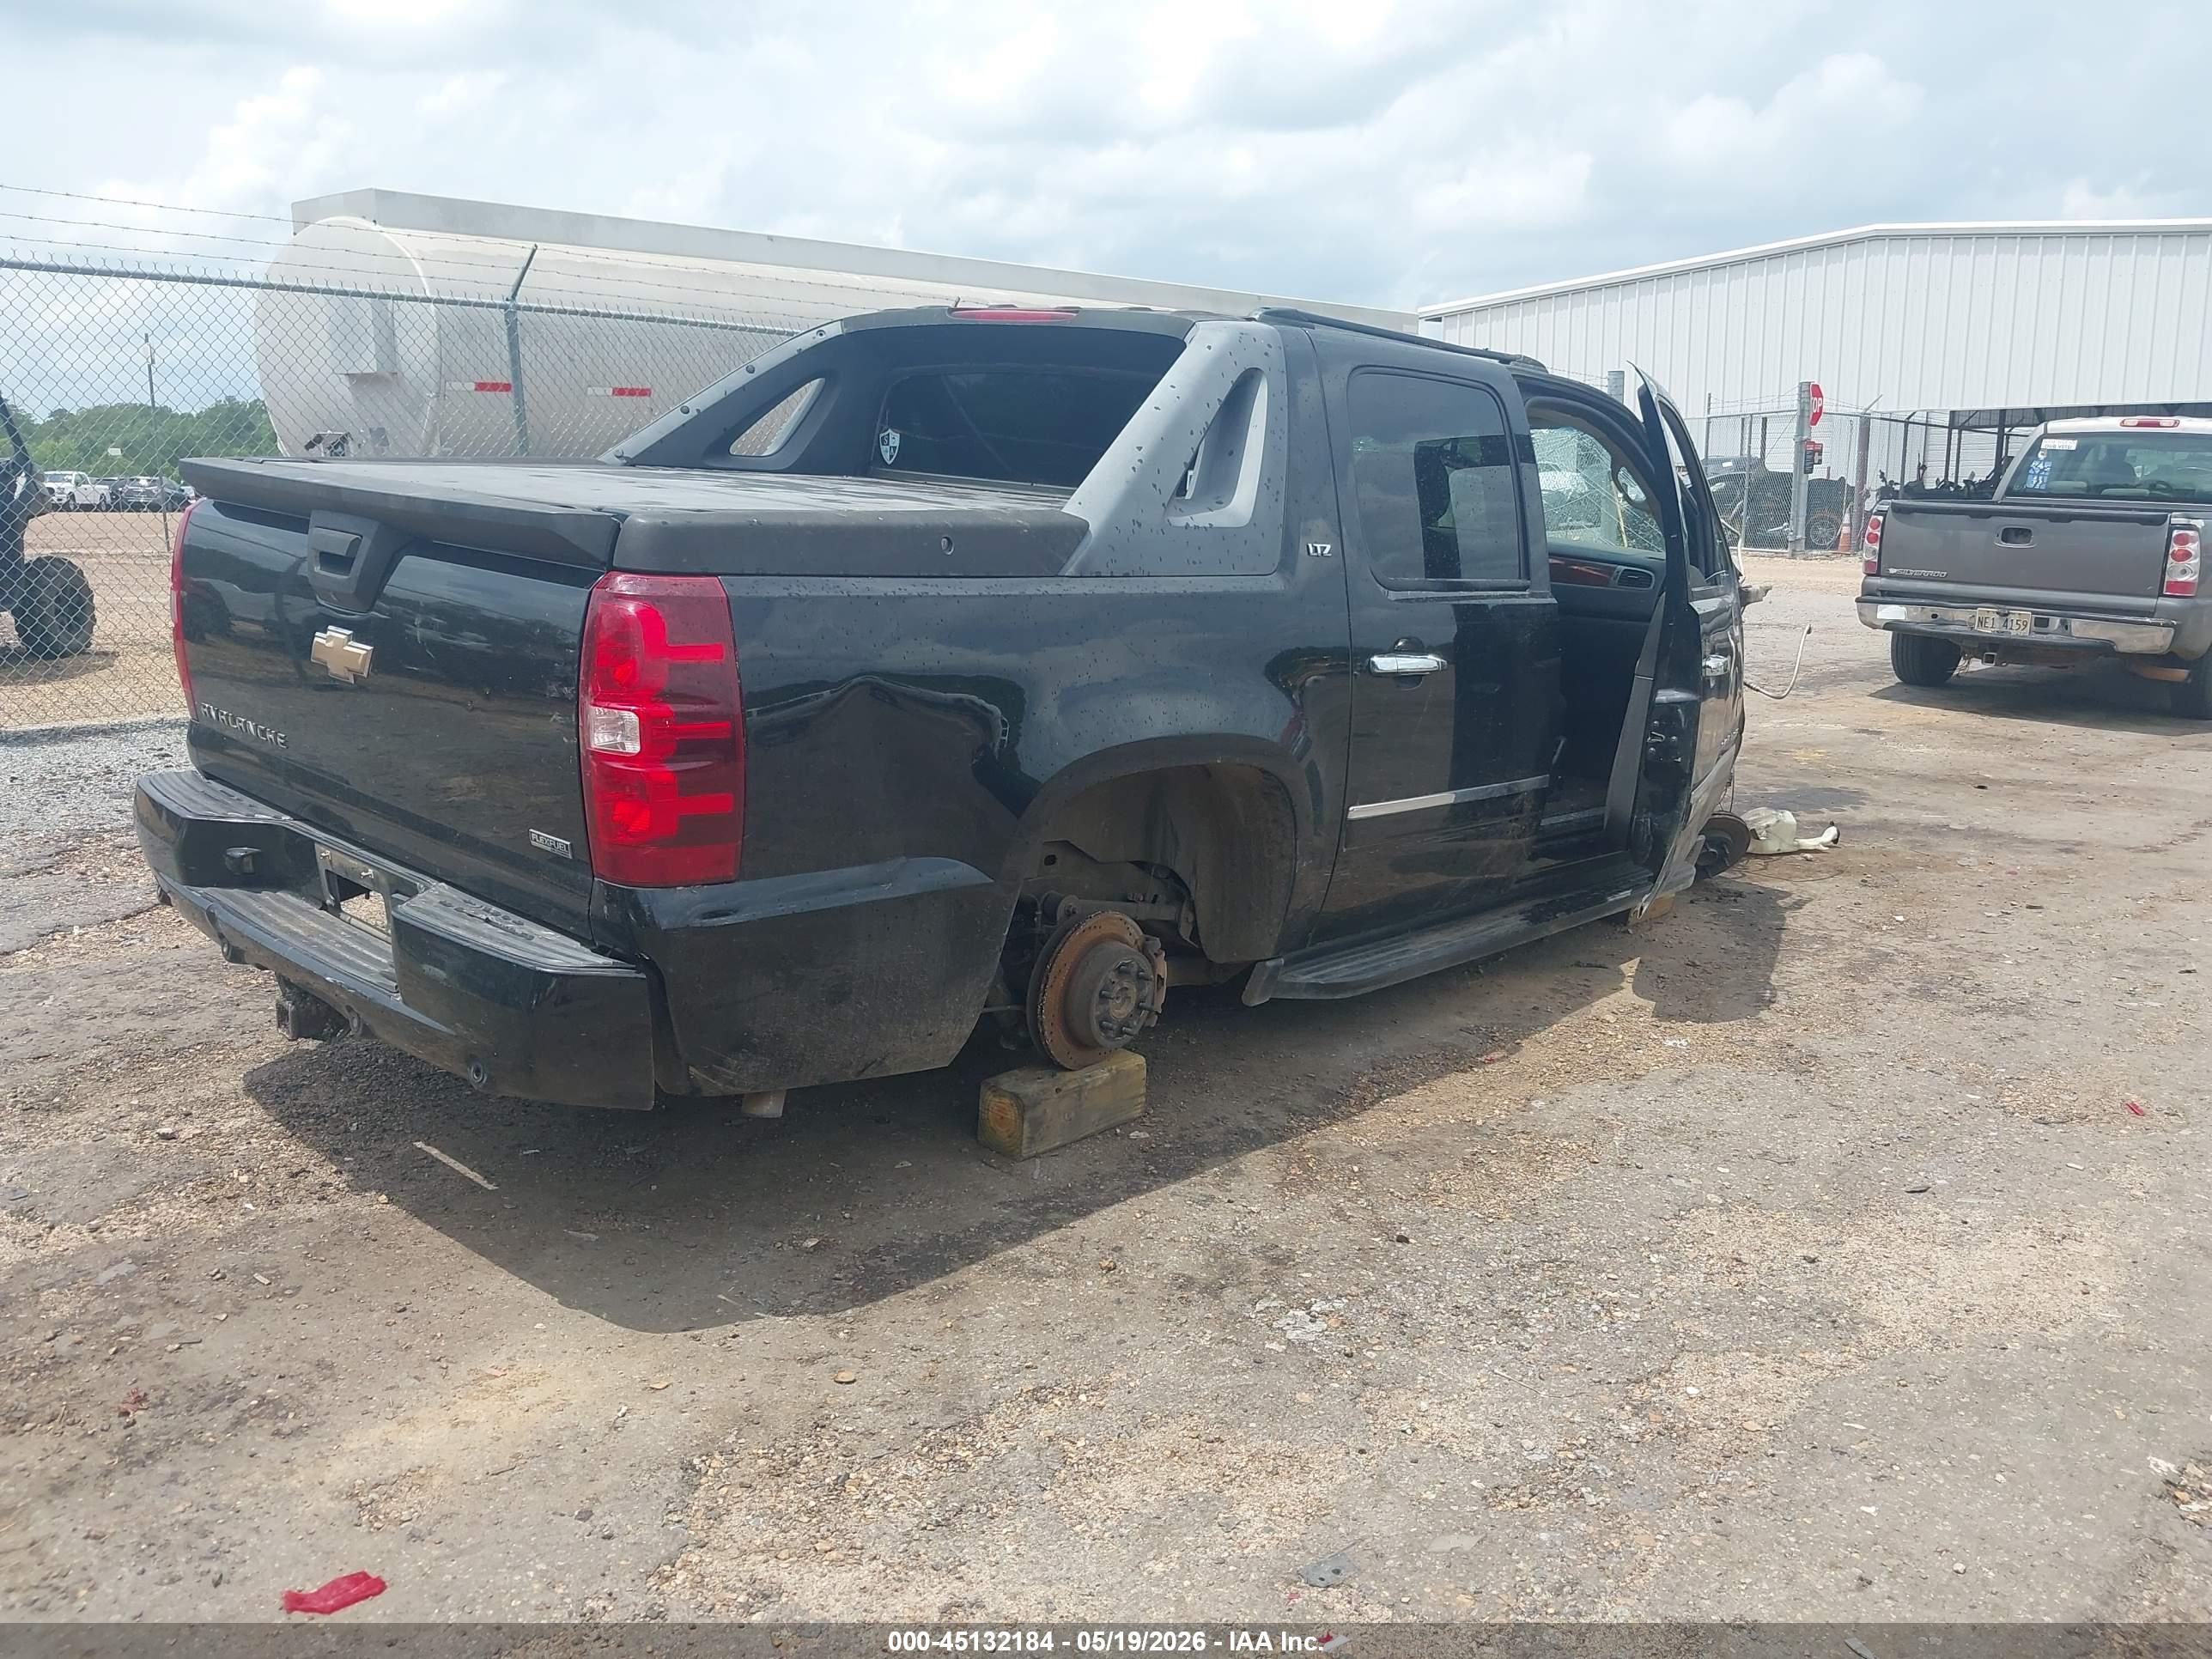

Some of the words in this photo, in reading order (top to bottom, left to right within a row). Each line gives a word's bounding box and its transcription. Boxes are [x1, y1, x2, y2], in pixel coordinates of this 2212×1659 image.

[1306, 543, 1332, 556] LTZ
[1895, 568, 1948, 578] SILVERADO
[2002, 617, 2028, 631] 4159
[200, 702, 289, 750] AVALANCHE
[531, 832, 568, 853] FLEXFUEL
